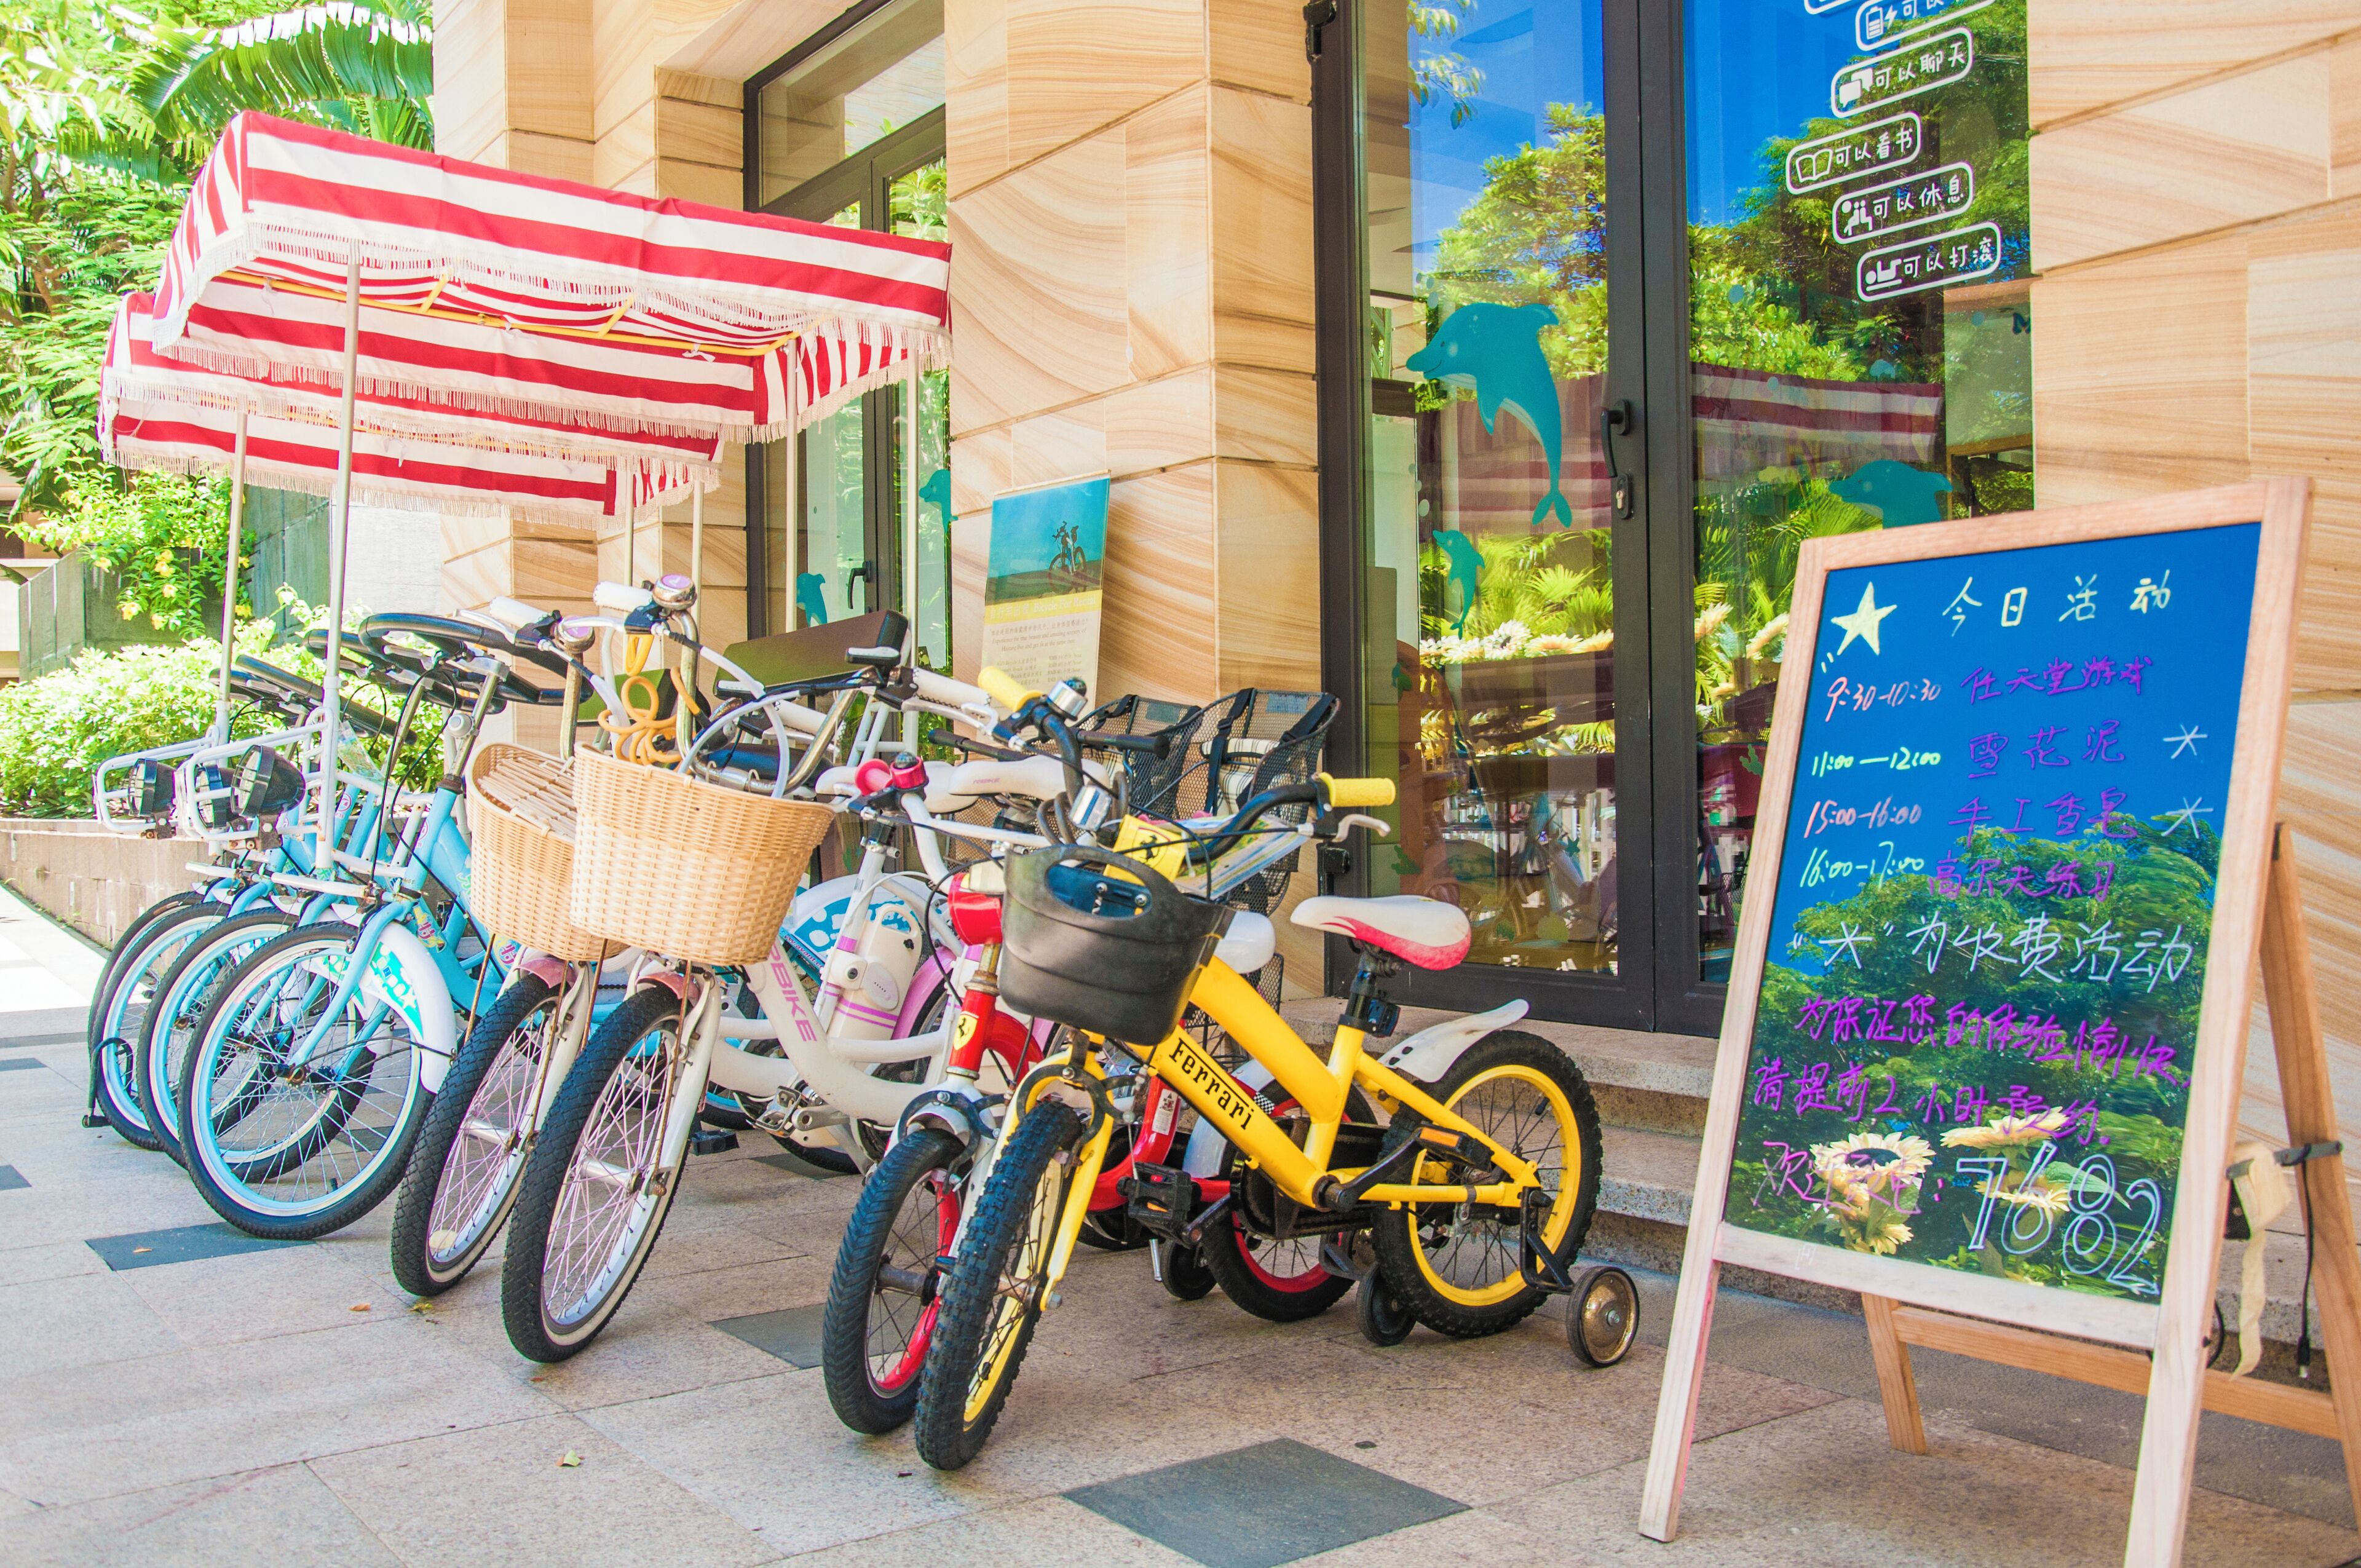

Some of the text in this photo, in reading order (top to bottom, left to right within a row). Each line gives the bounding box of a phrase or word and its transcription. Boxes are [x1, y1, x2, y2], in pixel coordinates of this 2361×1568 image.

[1874, 41, 1966, 89] 可以聊天
[1835, 127, 1913, 167] 可以看书
[1873, 174, 1964, 219] 可以休息
[1903, 236, 1994, 279] 可以打滚
[1942, 569, 2170, 637] 今日活动
[1825, 655, 2153, 722] 9:30-10:30 任天堂游戏
[1968, 719, 2126, 779] 雪花泥
[1803, 786, 2138, 848] 15:00-16:00 手工香皂
[1800, 841, 2116, 902] 16:00-17:00 高尔夫练习
[1169, 1037, 1255, 1130] Ferrari
[1955, 1139, 2161, 1296] 7682
